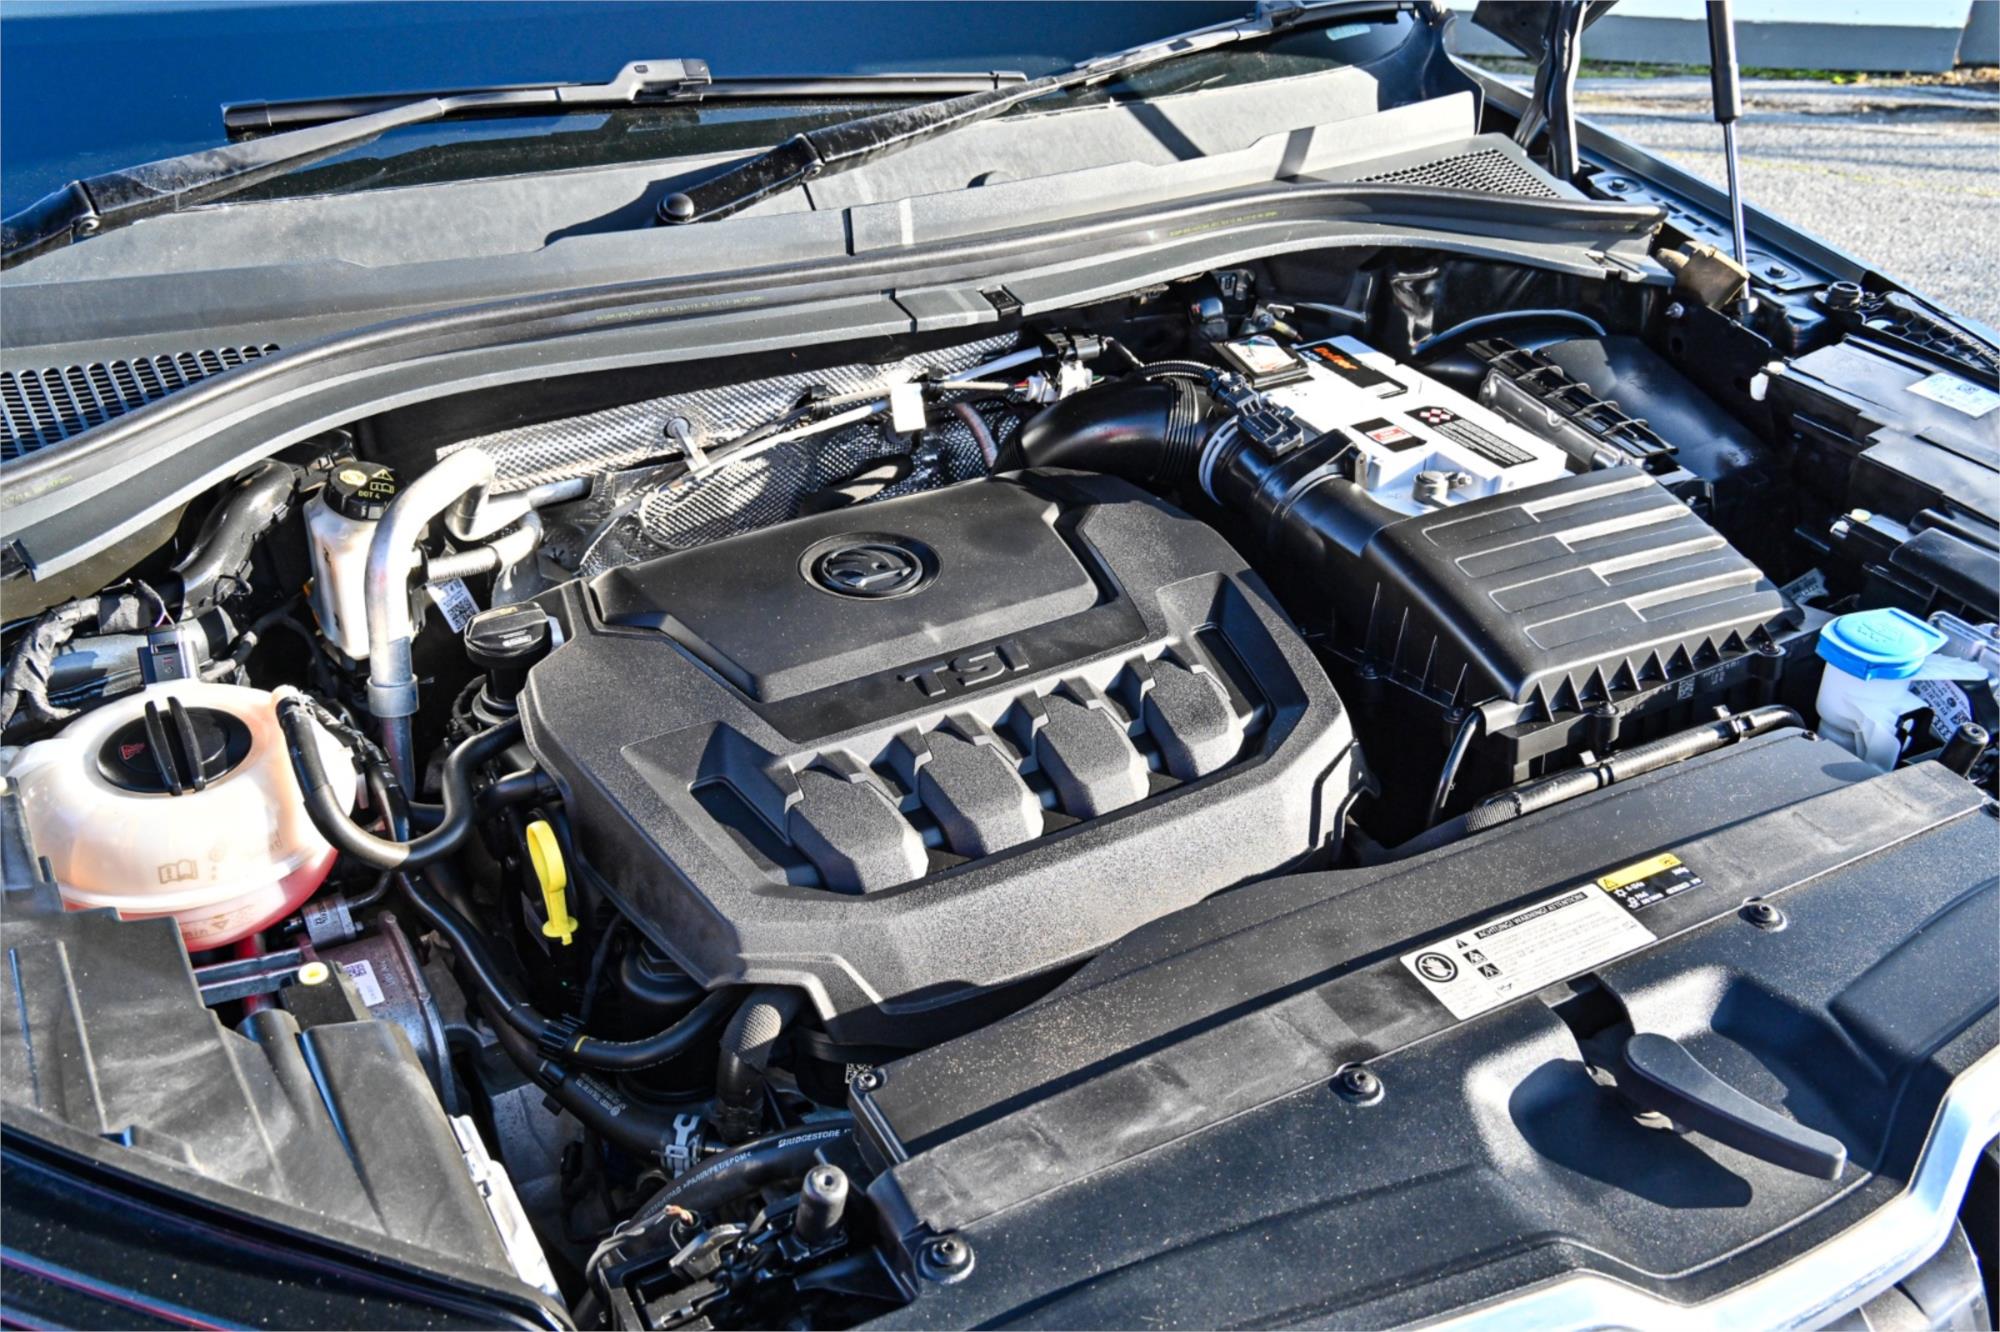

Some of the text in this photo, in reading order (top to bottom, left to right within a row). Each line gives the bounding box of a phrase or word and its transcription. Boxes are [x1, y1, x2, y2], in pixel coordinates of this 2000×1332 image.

[358, 490, 373, 499] DOT
[902, 639, 1030, 697] TSI
[777, 1129, 841, 1148] BRIDGESTONE
